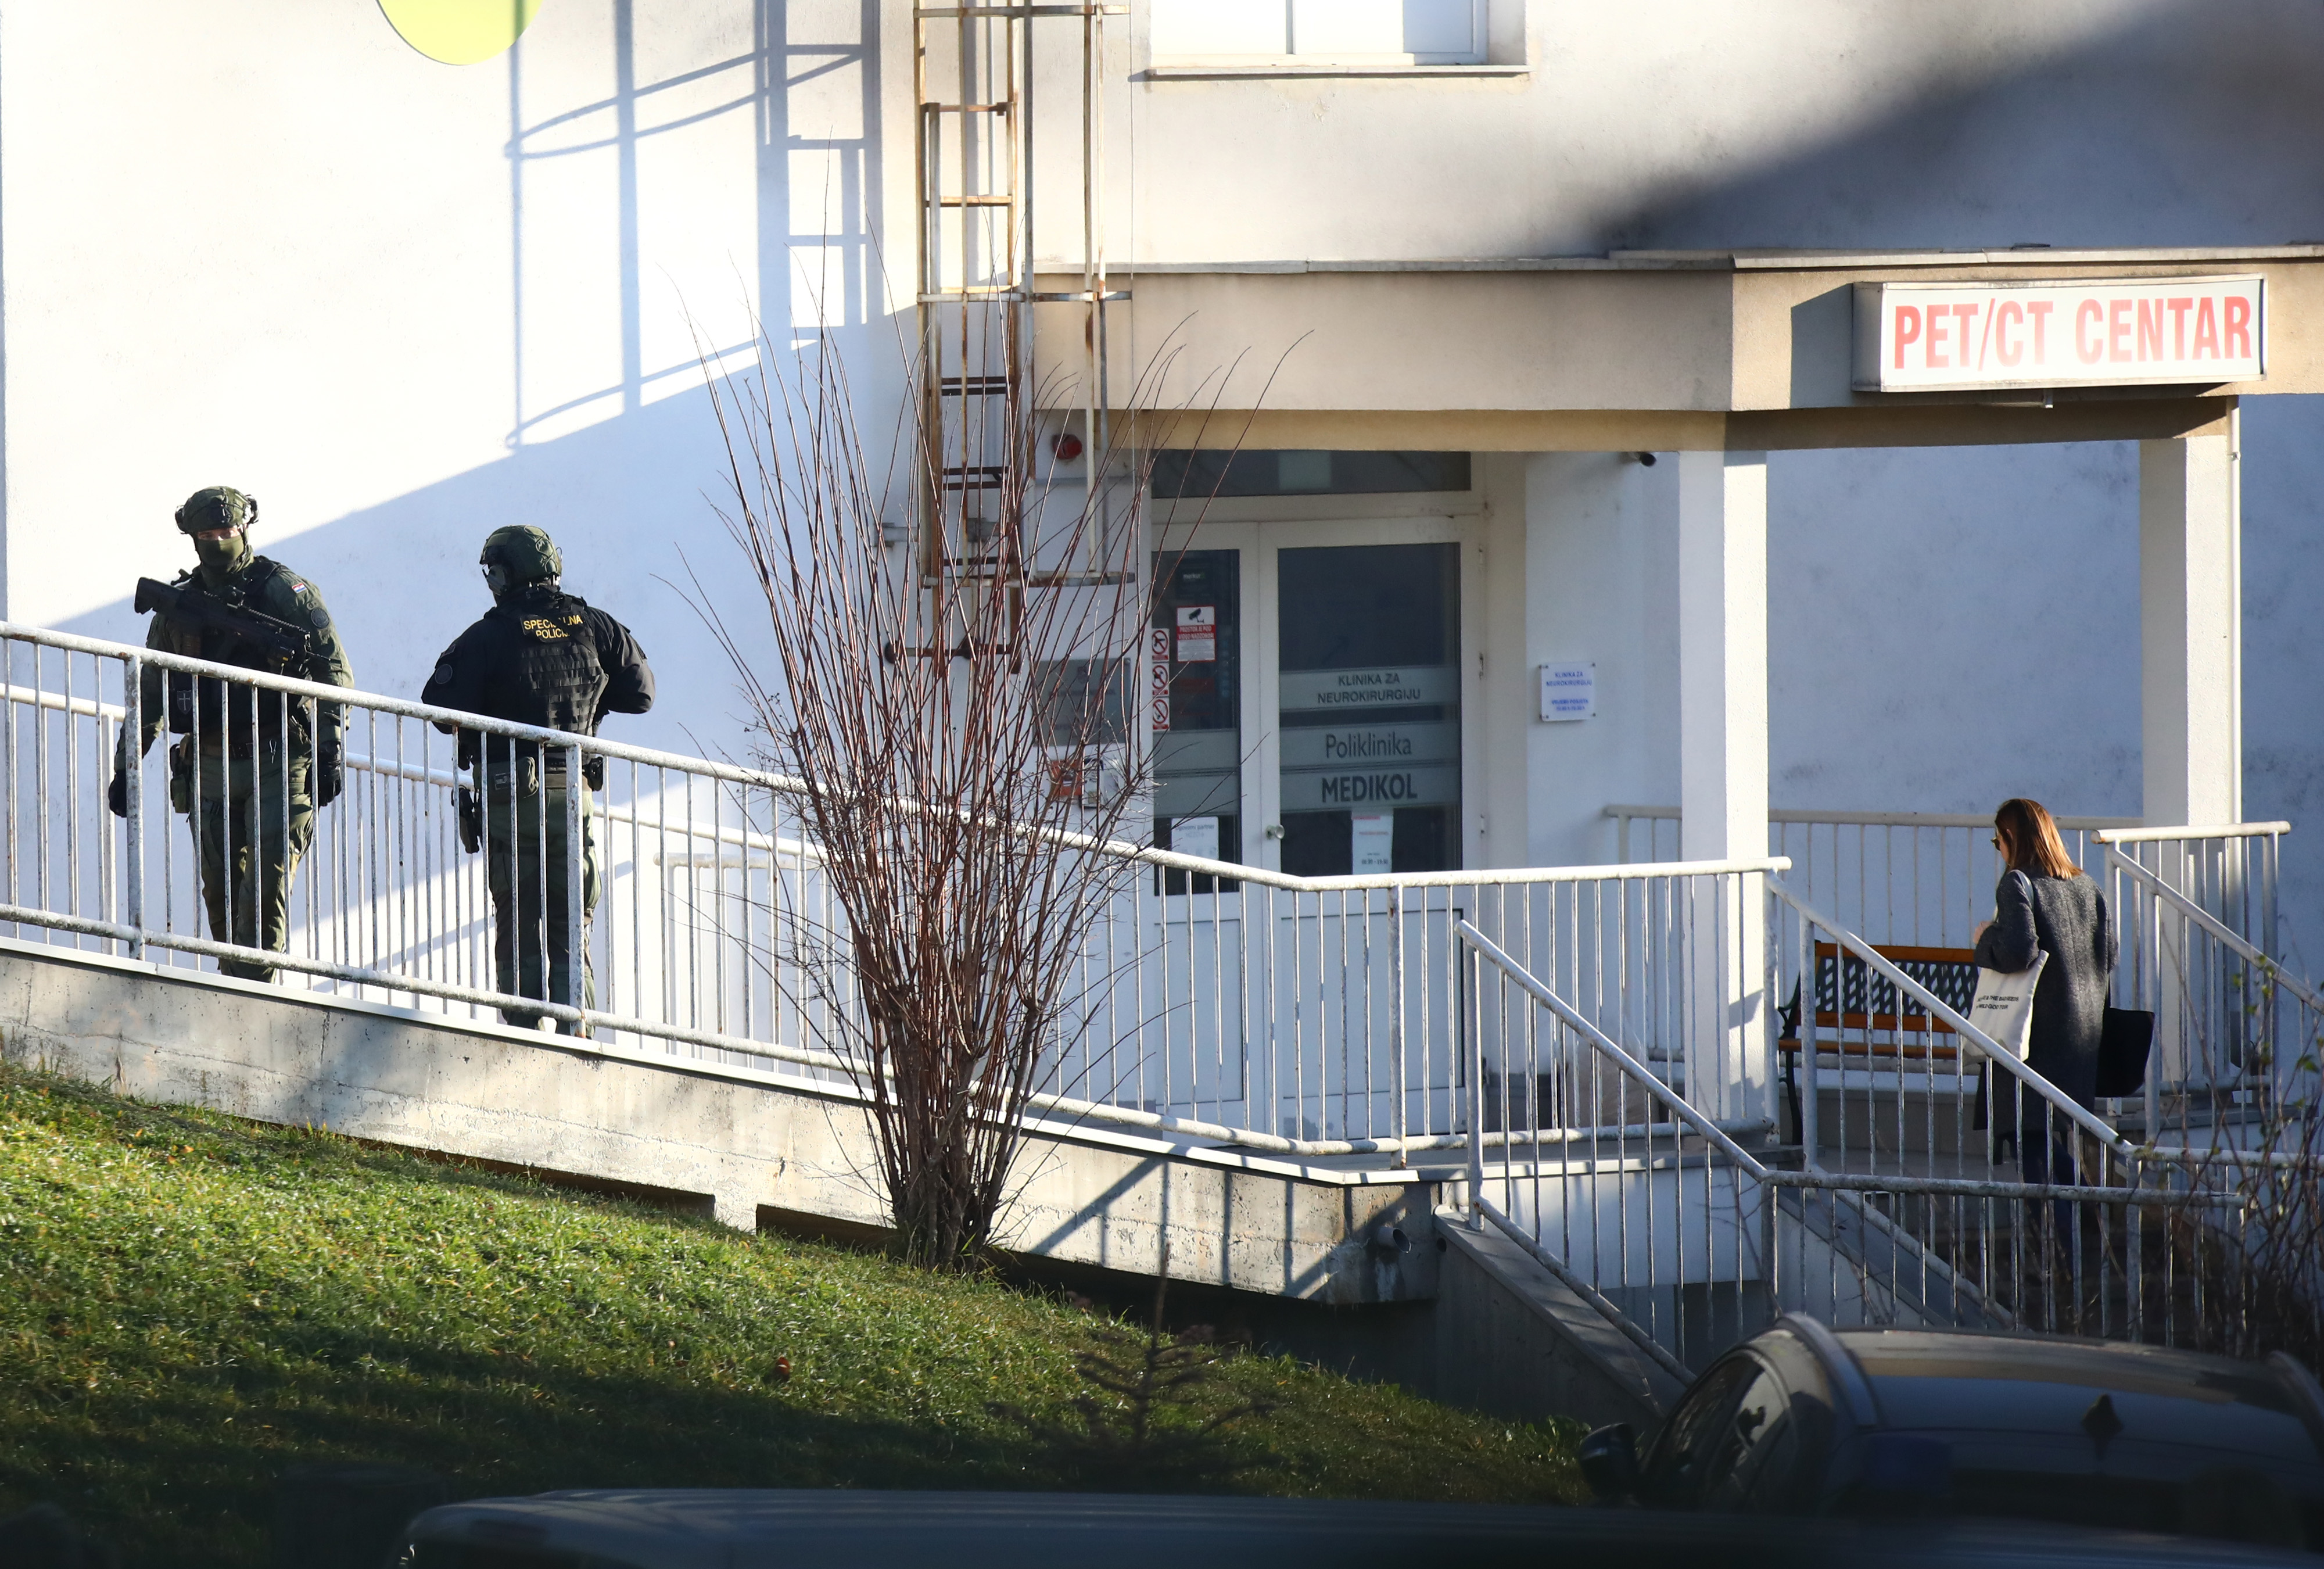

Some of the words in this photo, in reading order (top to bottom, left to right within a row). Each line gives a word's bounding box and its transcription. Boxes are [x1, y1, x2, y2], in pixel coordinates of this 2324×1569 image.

[1894, 298, 2053, 372] PET/CT
[2075, 296, 2252, 365] CENTAR
[523, 614, 583, 630] SPECILNA
[536, 628, 570, 639] POLICI
[1338, 673, 1382, 686] KLINIKA
[1385, 673, 1400, 683] ZA
[1318, 689, 1421, 704] NEUROKIRURGIJU
[1325, 732, 1412, 758] Poliklinika
[1321, 773, 1418, 803] MEDIKOL
